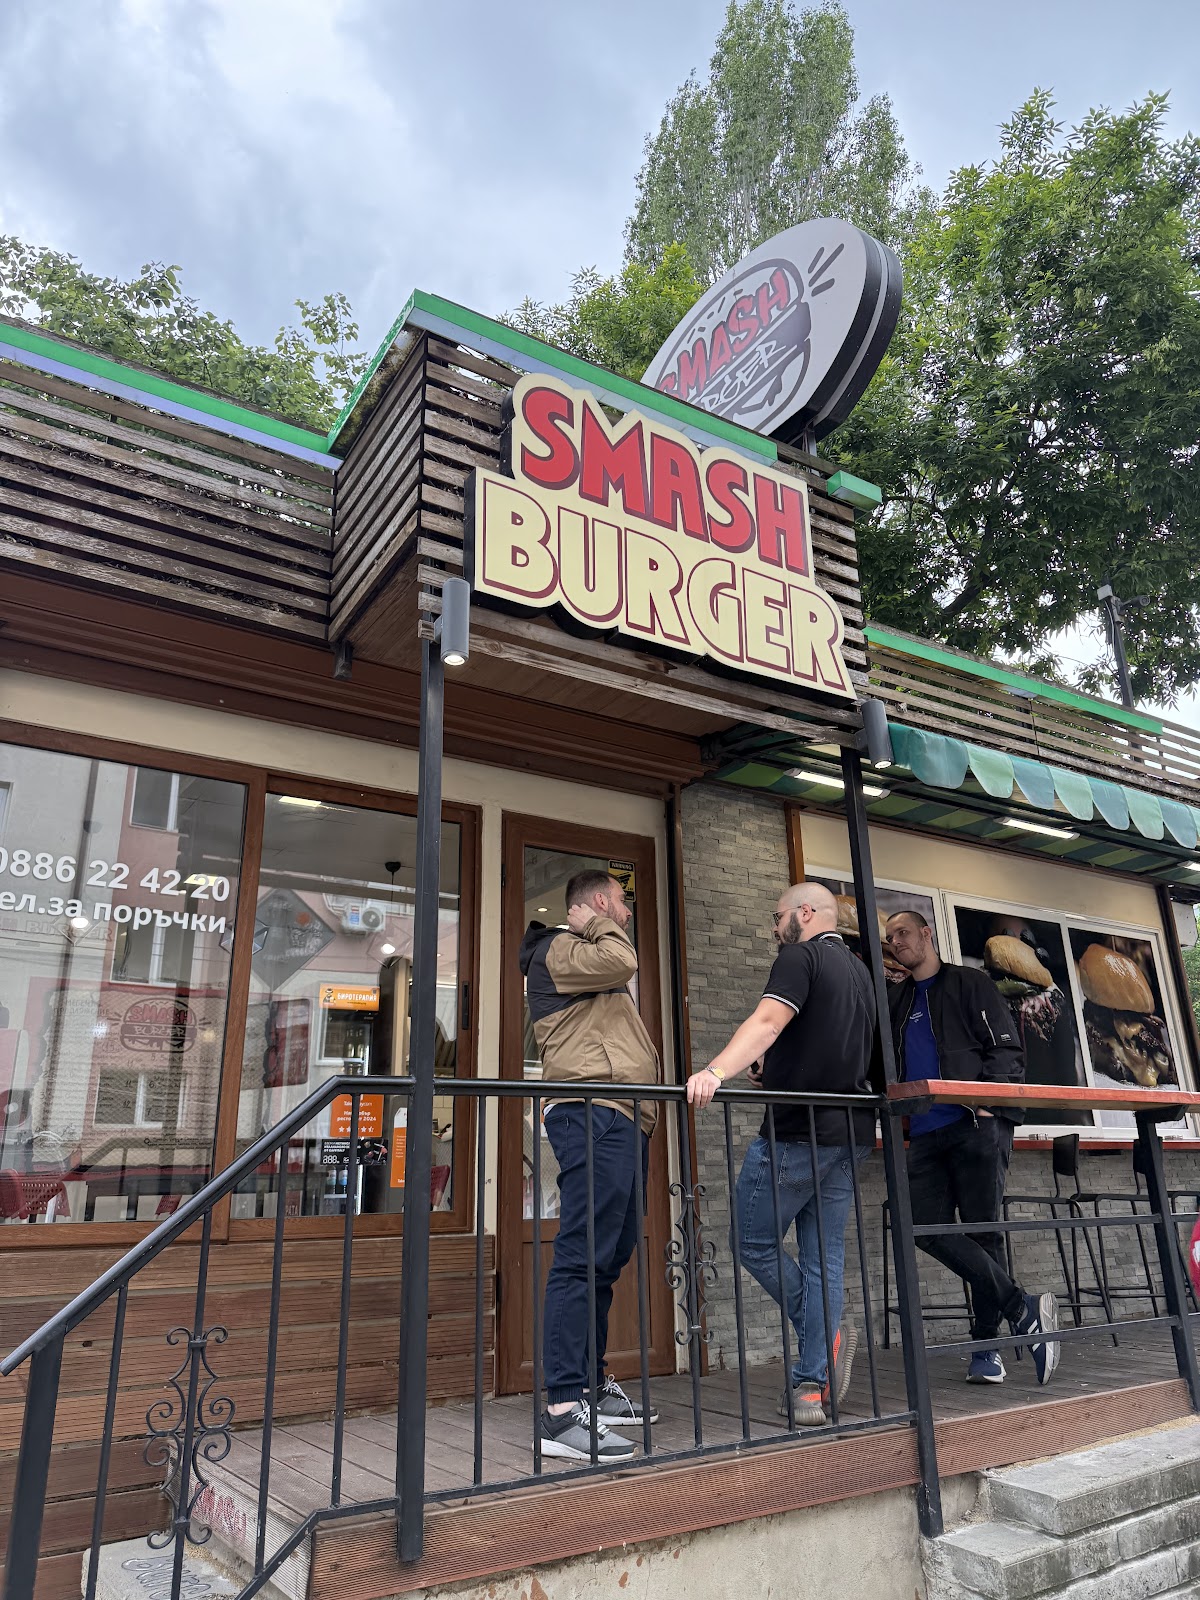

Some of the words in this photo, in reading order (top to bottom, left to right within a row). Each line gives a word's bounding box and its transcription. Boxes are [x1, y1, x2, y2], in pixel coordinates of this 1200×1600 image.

[700, 339, 787, 413] RGER
[521, 385, 809, 577] SMASH
[482, 478, 847, 692] BURGER
[87, 859, 130, 890] 22
[140, 867, 182, 896] 42
[191, 873, 230, 902] 20
[94, 901, 226, 934] поръчки
[128, 1003, 193, 1025] SMASH
[134, 1025, 185, 1037] BURGER
